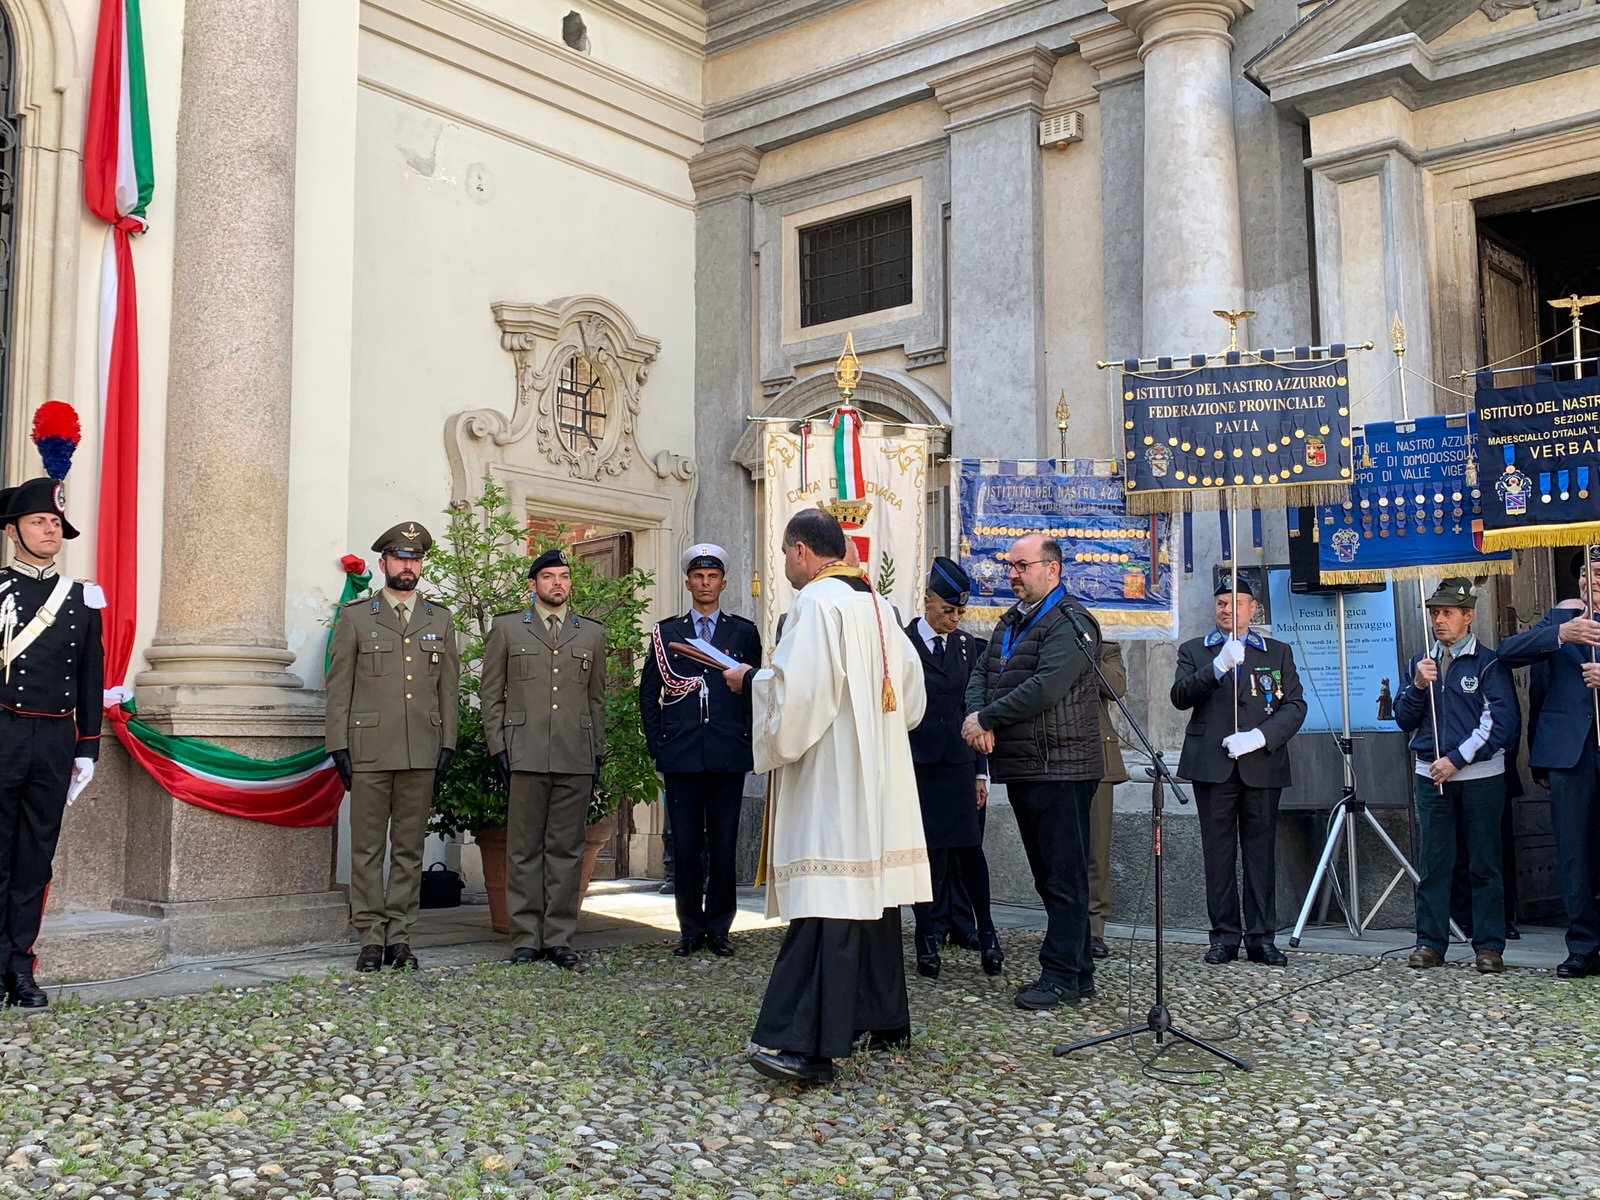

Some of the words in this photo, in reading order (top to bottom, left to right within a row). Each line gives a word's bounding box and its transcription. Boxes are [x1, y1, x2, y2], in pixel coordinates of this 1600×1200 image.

[1136, 385, 1193, 400] ISTITUTO
[1196, 383, 1221, 396] DEL
[1223, 379, 1273, 394] NASTRO
[1275, 375, 1336, 391] AZZURRO
[1149, 402, 1236, 419] FEDERAZIONE
[1239, 395, 1326, 412] PROVINCIALE
[1481, 404, 1533, 420] ISTITUTO
[1536, 401, 1559, 414] DEL
[1562, 395, 1600, 411] NASTR
[1215, 420, 1259, 434] PAVIA
[1554, 412, 1599, 425] SEZIONE
[1375, 442, 1391, 453] DEL
[1396, 438, 1435, 452] NASTRO
[1441, 433, 1479, 448] AZZURR
[1488, 431, 1551, 447] MARESCIALLO
[1552, 427, 1588, 438] D'ITALIA
[1387, 456, 1397, 467] DI
[1403, 449, 1478, 467] DOMODOSSOLA
[1530, 439, 1600, 459] VERBA
[1382, 470, 1392, 482] DI
[1401, 466, 1431, 480] VALLE
[864, 480, 903, 510] OVARA
[986, 485, 1031, 498] ISTITUTO
[1035, 486, 1053, 498] DEL
[1058, 485, 1096, 499] NASTRO
[1299, 608, 1324, 618] Festa
[1326, 607, 1367, 619] litrgica
[1276, 623, 1321, 632] Madonna
[1324, 621, 1334, 631] di
[1337, 620, 1392, 632] aravaggio
